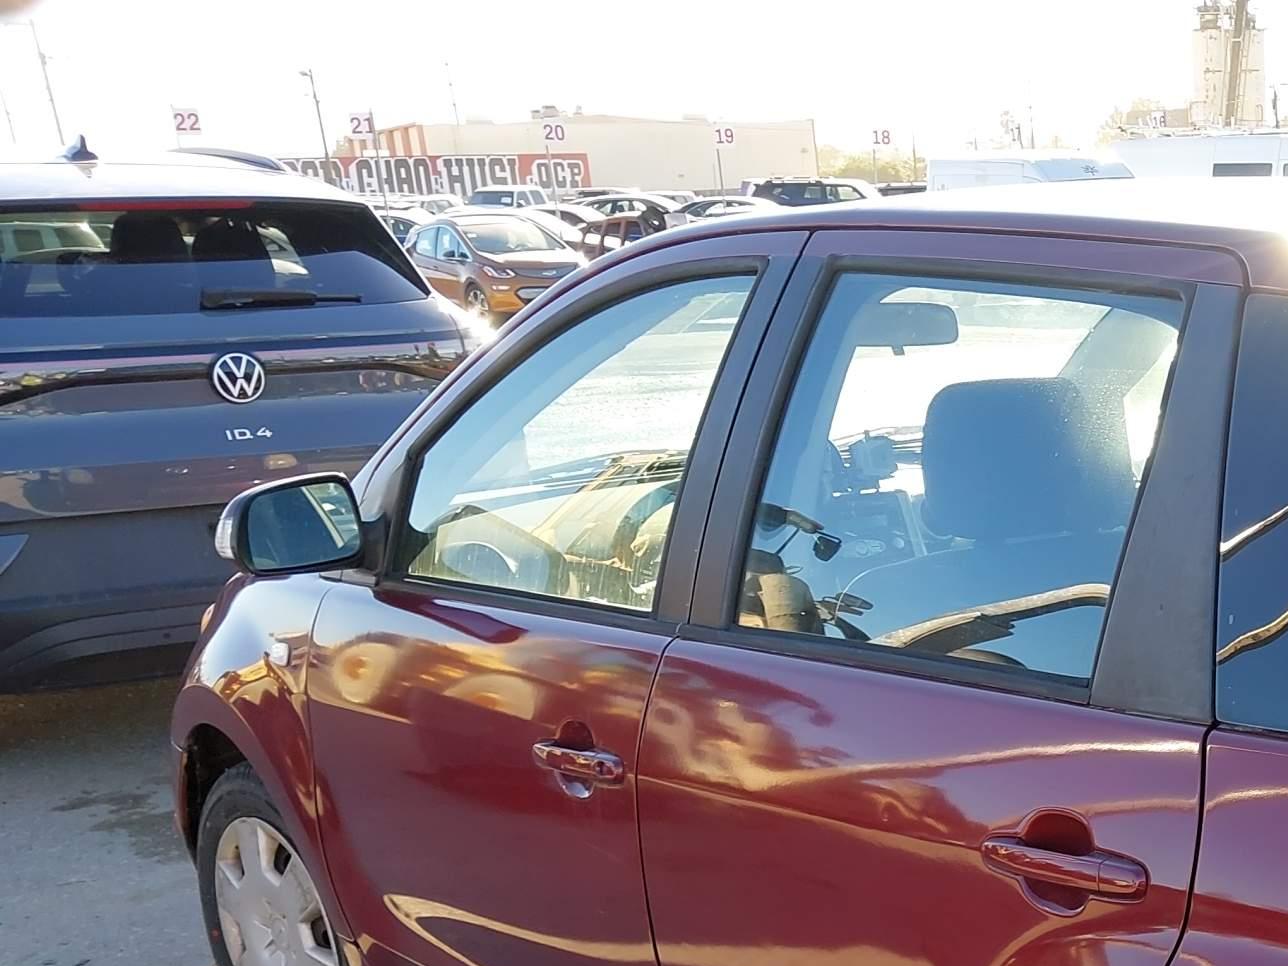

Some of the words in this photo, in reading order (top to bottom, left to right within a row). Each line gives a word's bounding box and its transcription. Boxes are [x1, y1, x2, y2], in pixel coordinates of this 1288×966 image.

[174, 112, 201, 132] 22
[351, 116, 373, 135] 21
[543, 124, 565, 141] 20
[715, 128, 734, 144] 19
[873, 130, 891, 145] 18
[214, 353, 265, 403] VW
